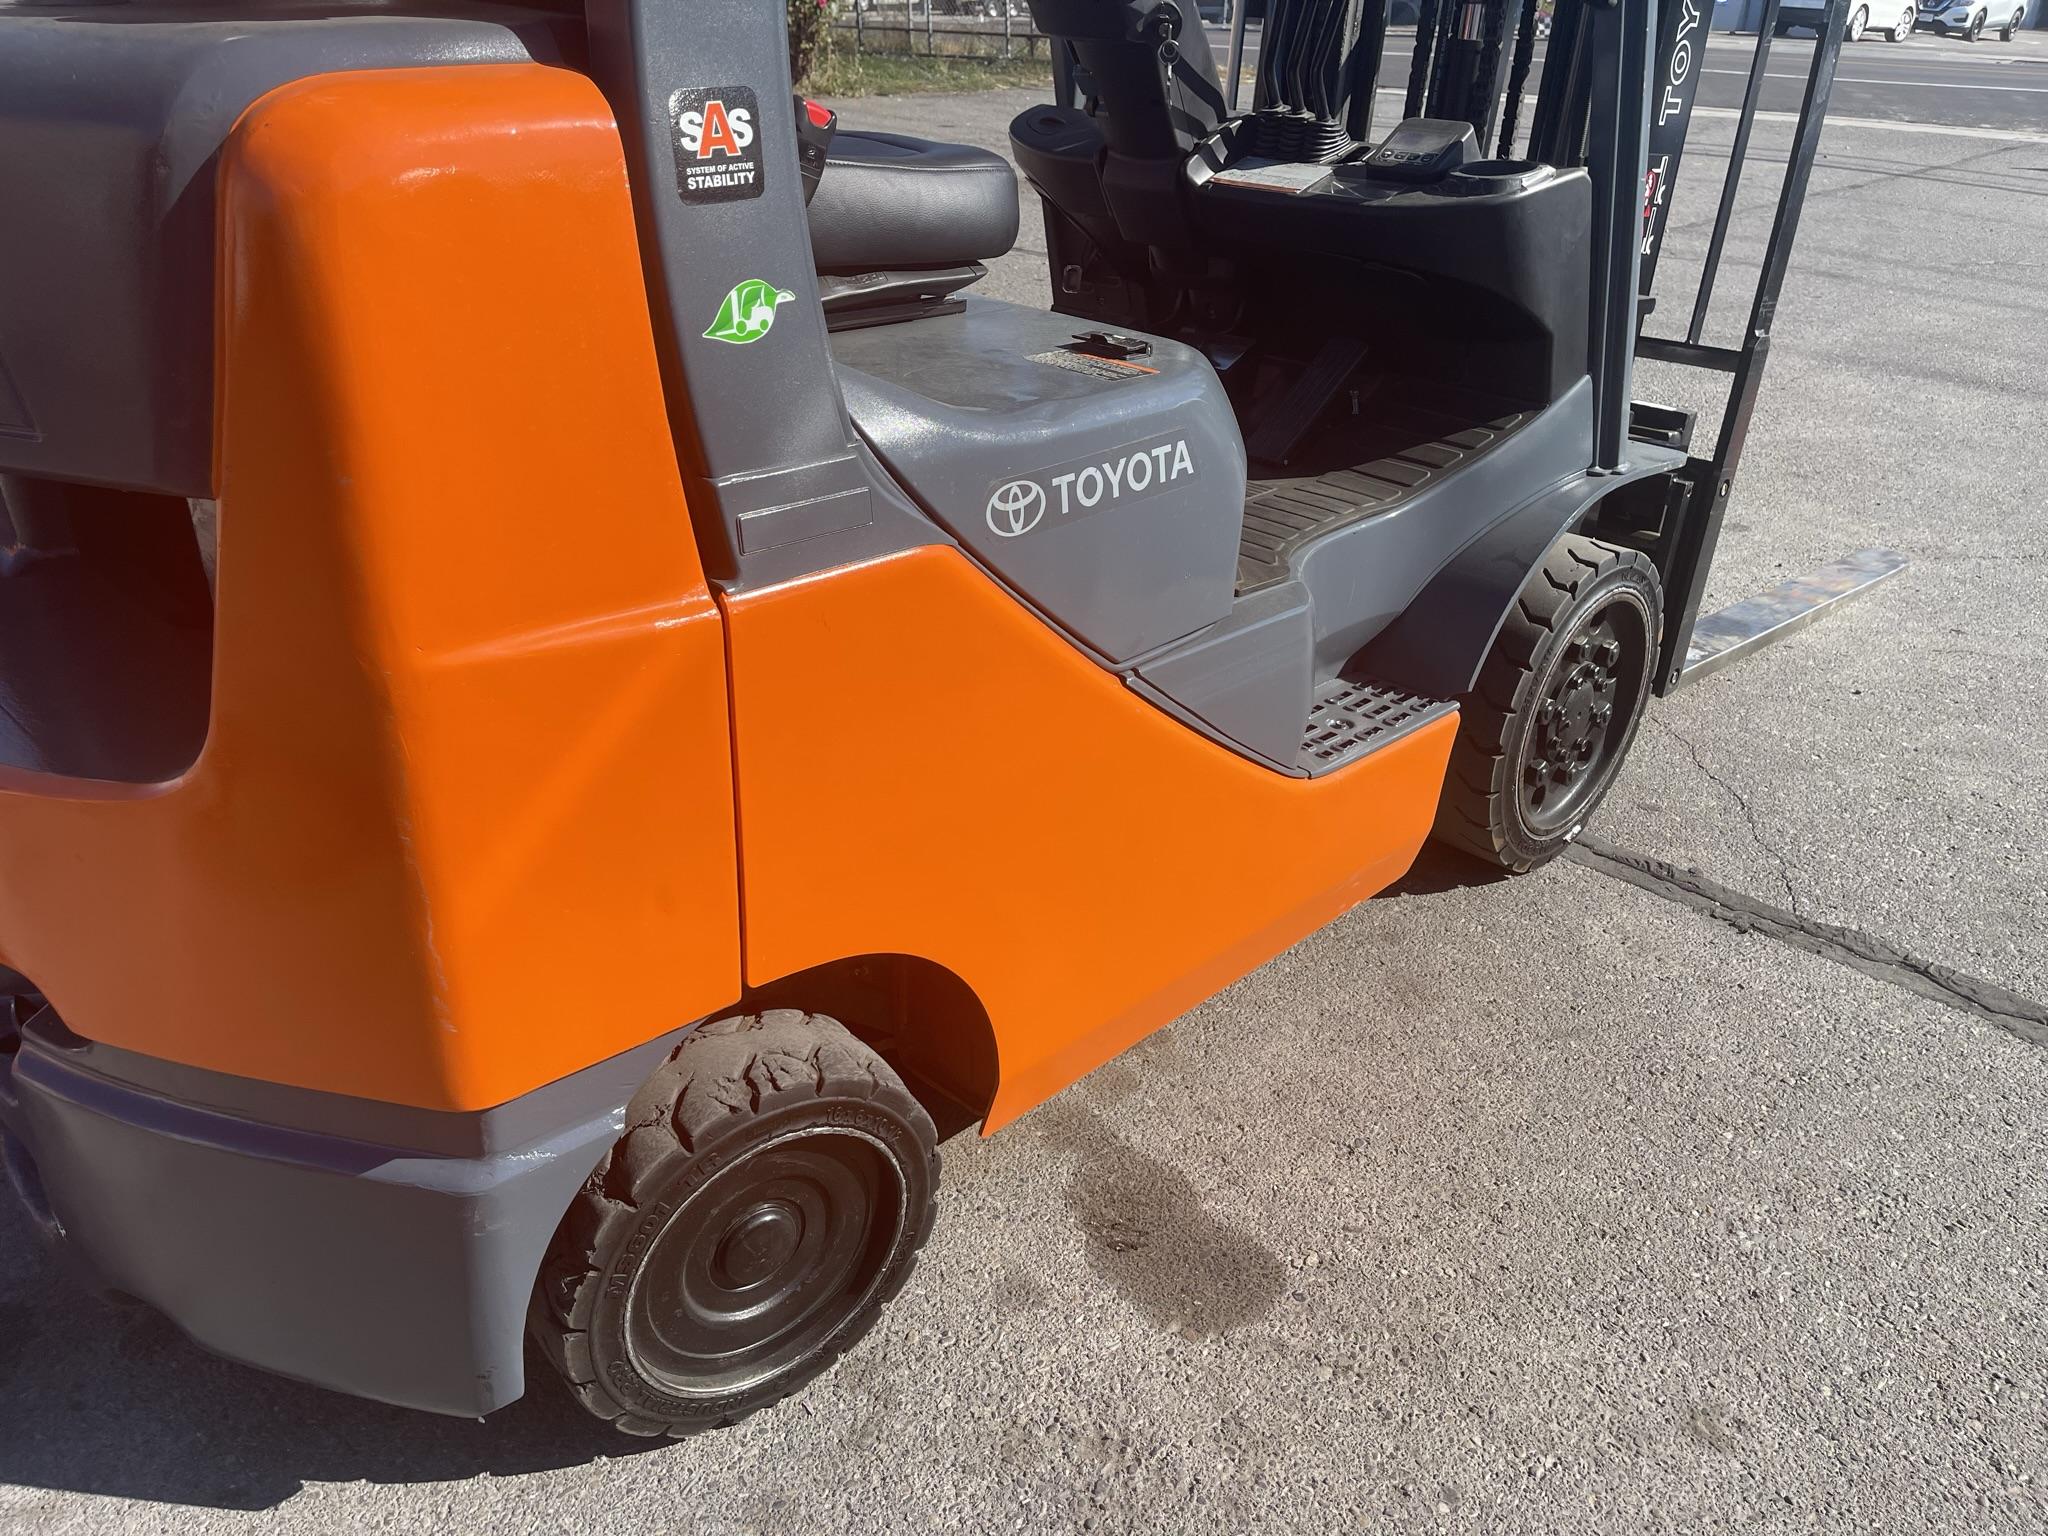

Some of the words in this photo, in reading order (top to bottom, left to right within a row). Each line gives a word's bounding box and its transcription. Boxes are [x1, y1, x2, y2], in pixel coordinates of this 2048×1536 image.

[679, 101, 754, 159] SAS
[686, 164, 716, 176] SYSTEM
[717, 163, 727, 173] OF
[727, 161, 755, 172] ACTIVE
[687, 171, 755, 190] STABILITY
[1052, 440, 1194, 515] TOYOTA
